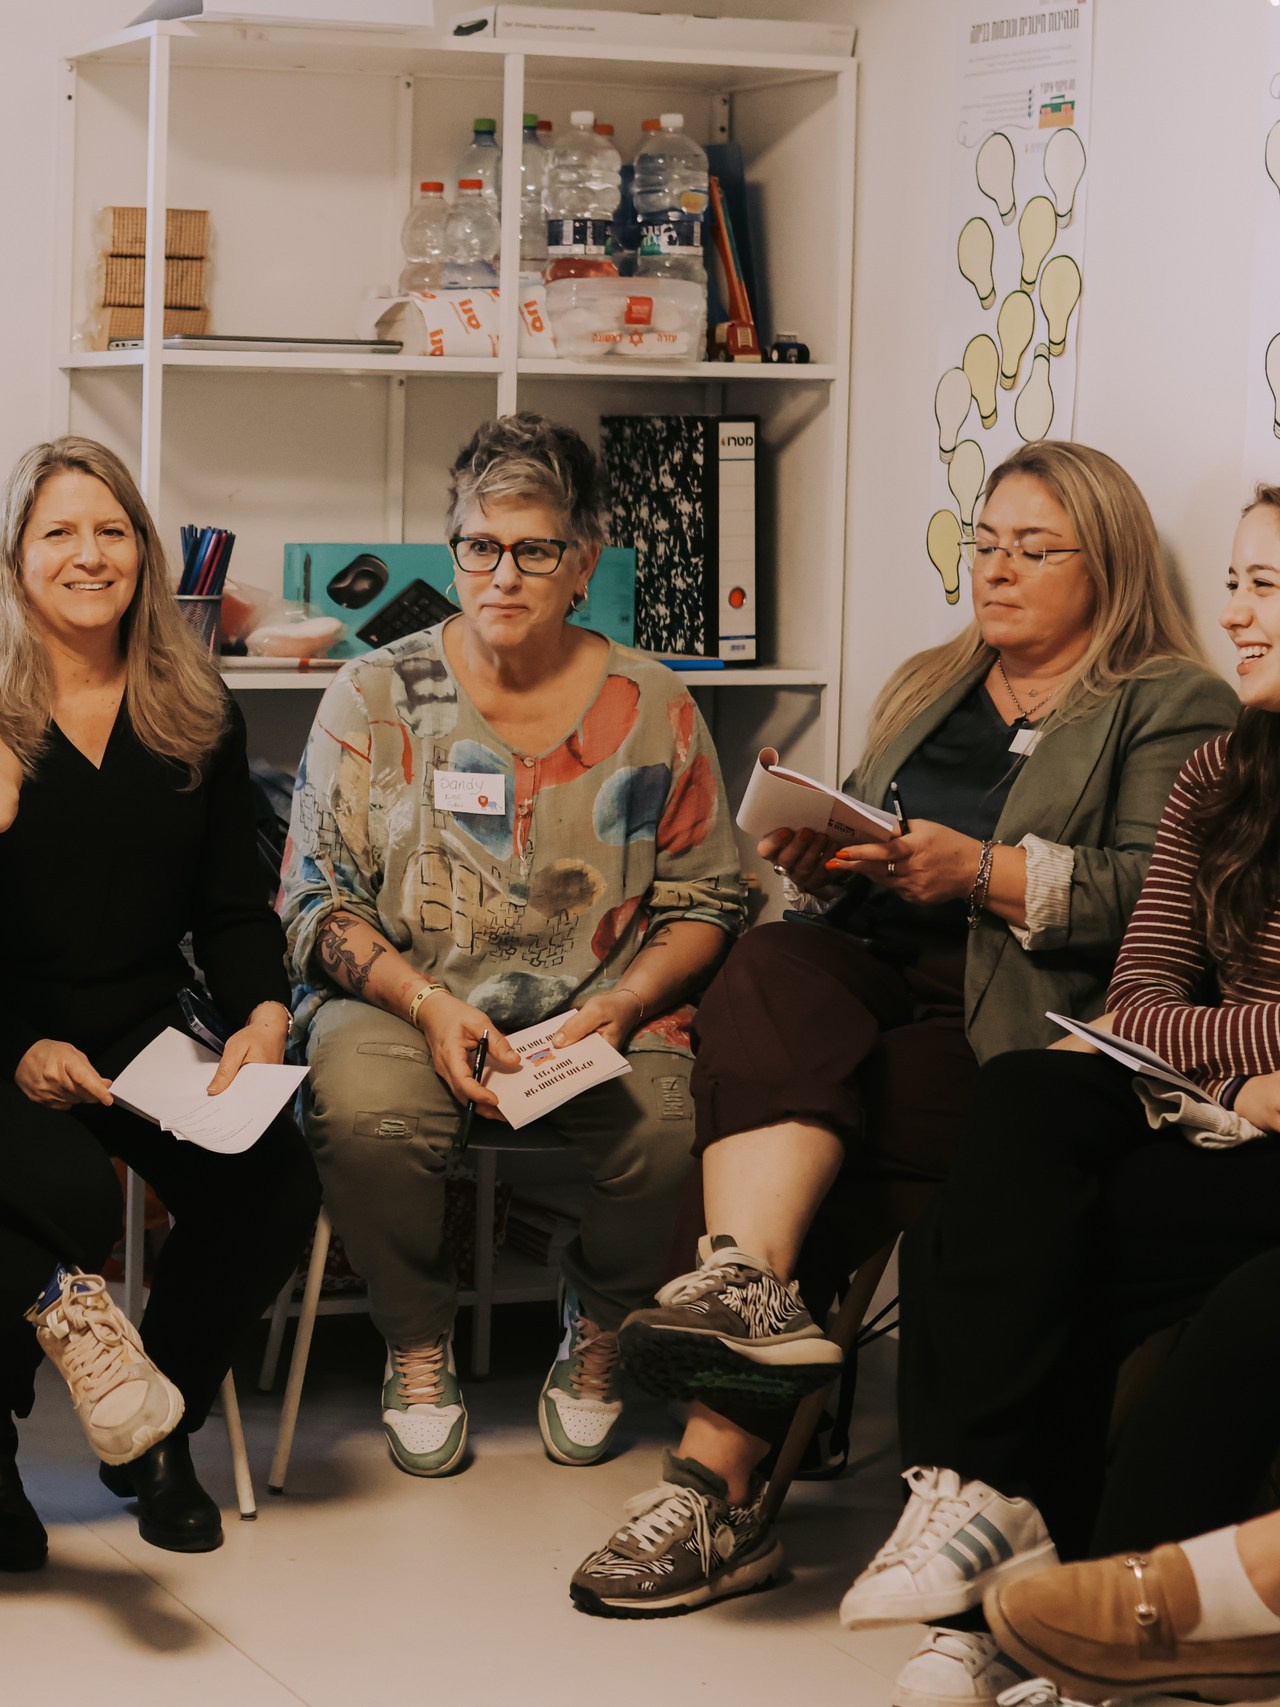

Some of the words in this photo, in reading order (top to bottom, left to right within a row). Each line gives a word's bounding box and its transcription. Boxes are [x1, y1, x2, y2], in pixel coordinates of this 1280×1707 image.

[656, 333, 678, 343] עזרה
[727, 436, 754, 446] מטרו
[440, 778, 484, 795] Sandy
[524, 1086, 539, 1098] אני
